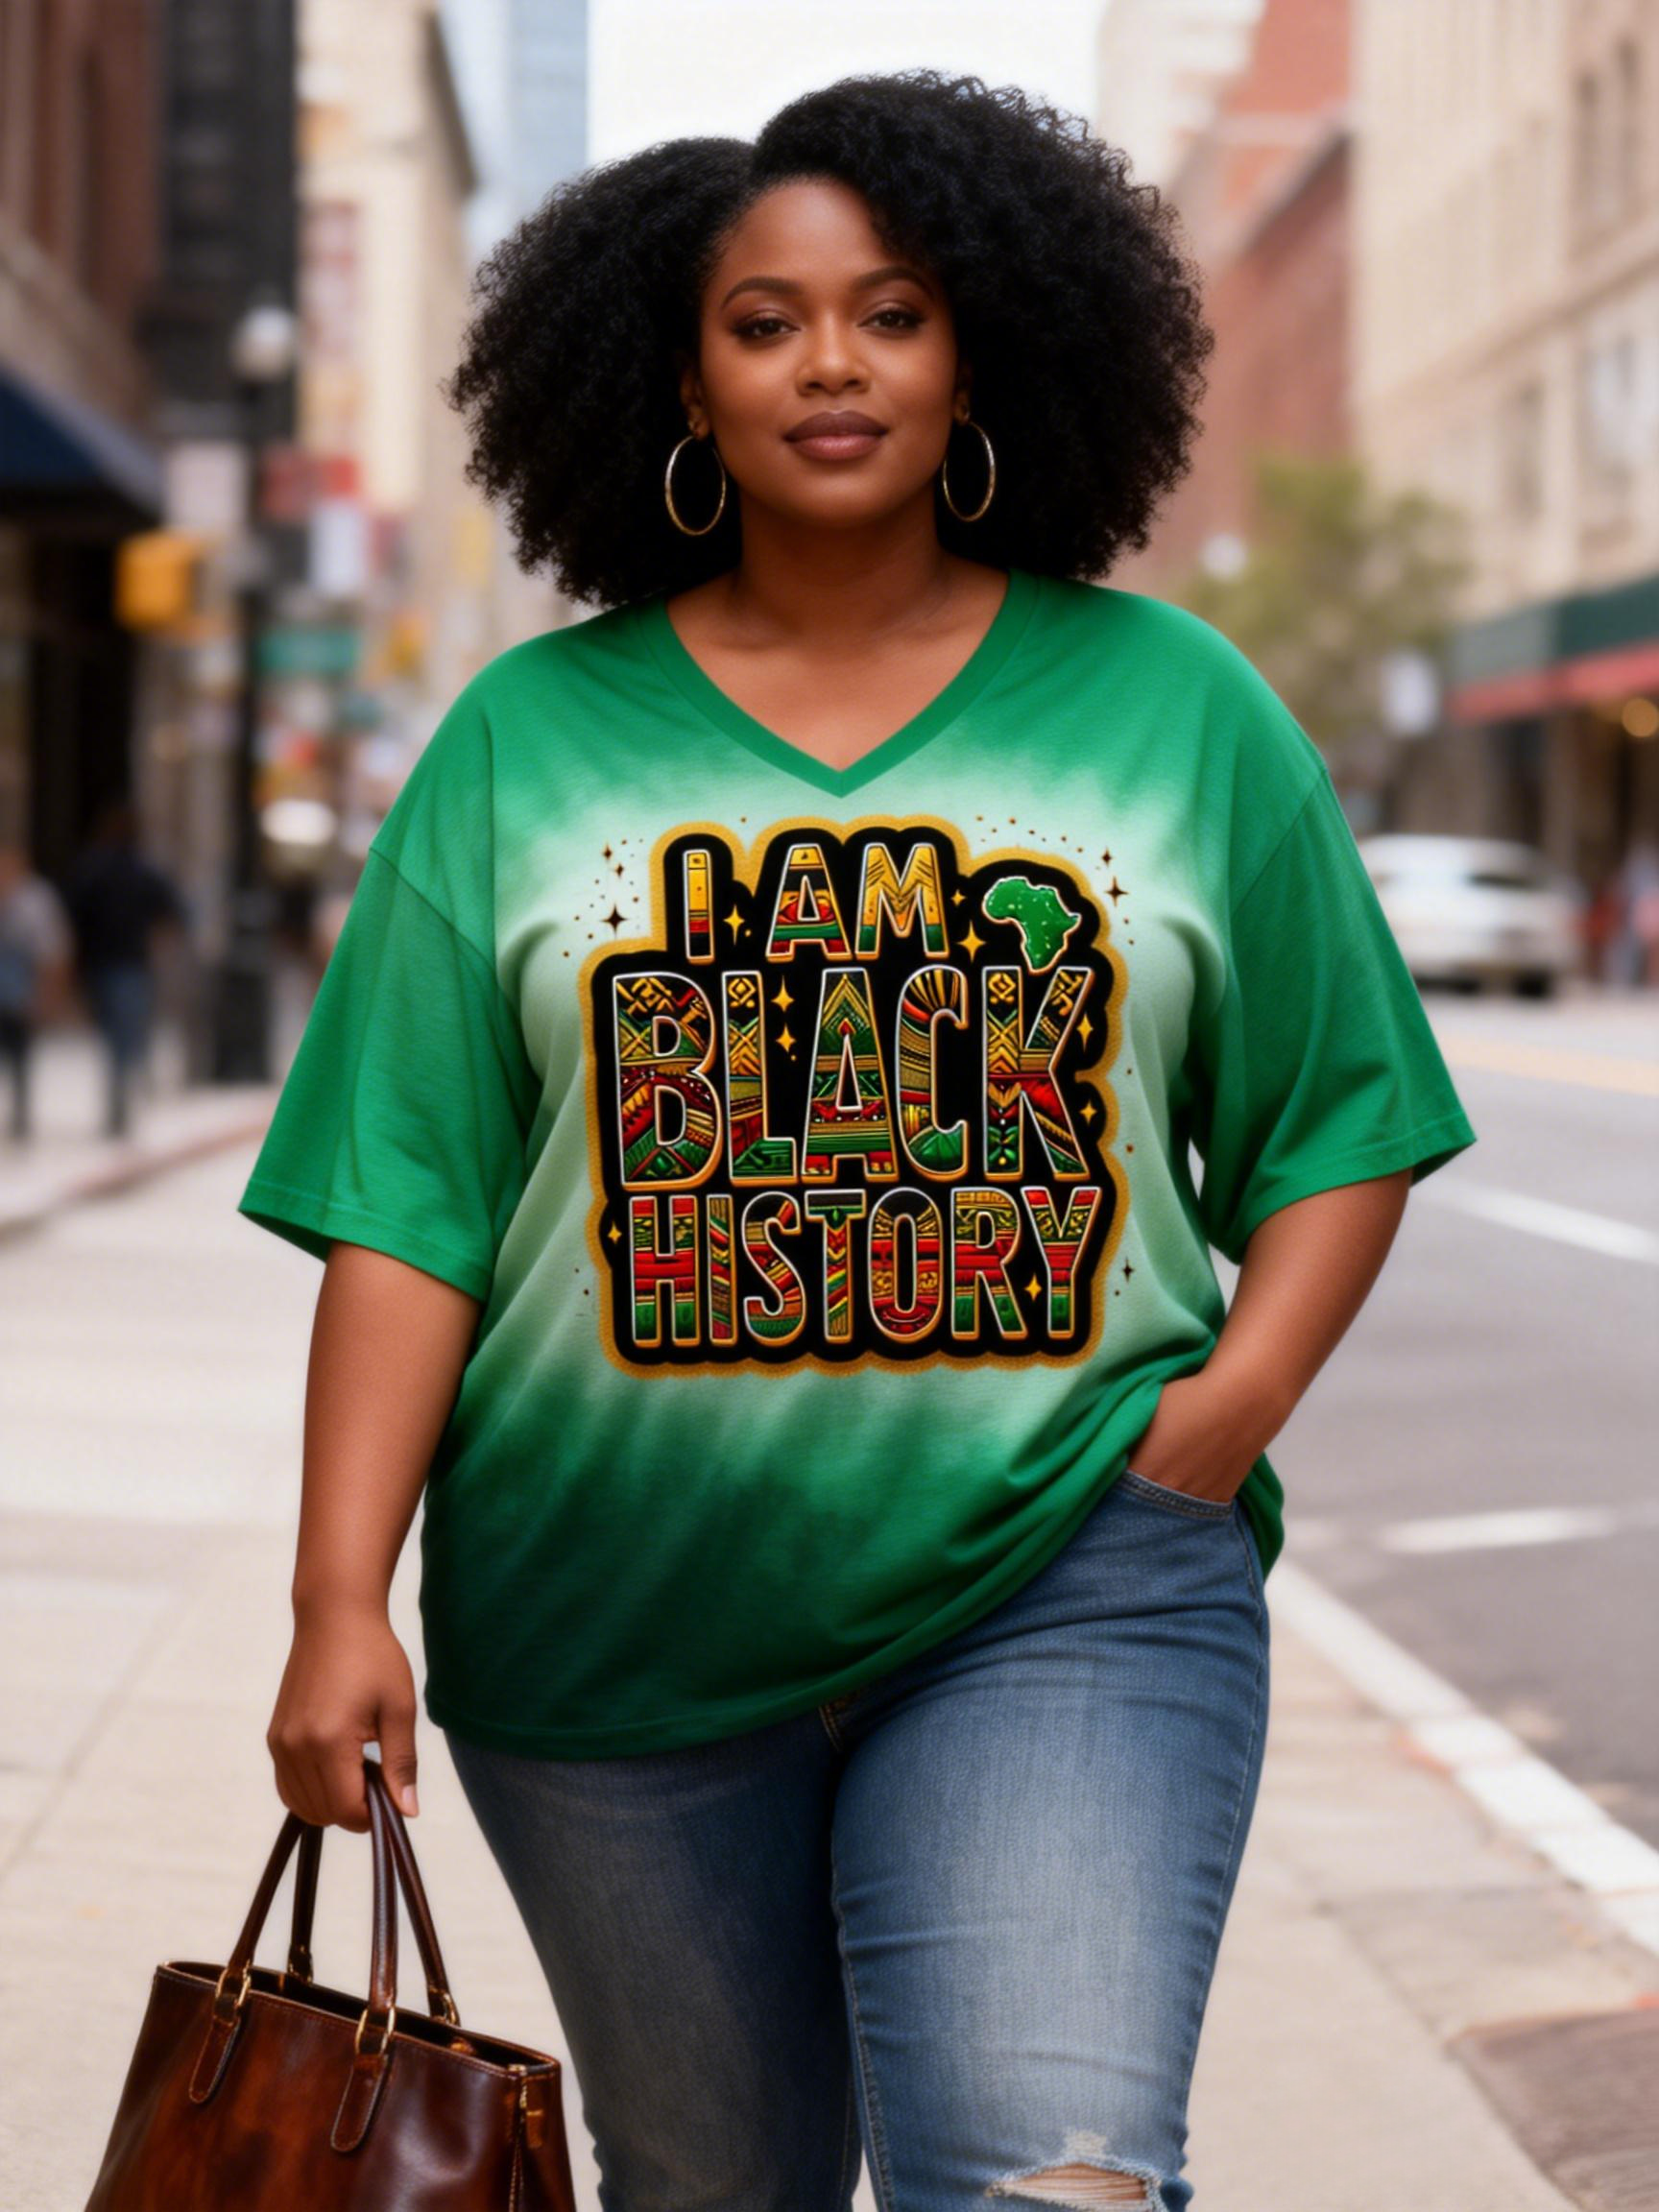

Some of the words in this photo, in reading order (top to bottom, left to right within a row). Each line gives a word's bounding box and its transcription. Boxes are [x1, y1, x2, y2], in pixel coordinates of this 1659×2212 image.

[683, 849, 714, 962] I
[766, 843, 950, 960] AM
[613, 965, 1094, 1188] BLACK
[629, 1187, 1102, 1346] HISTORY
